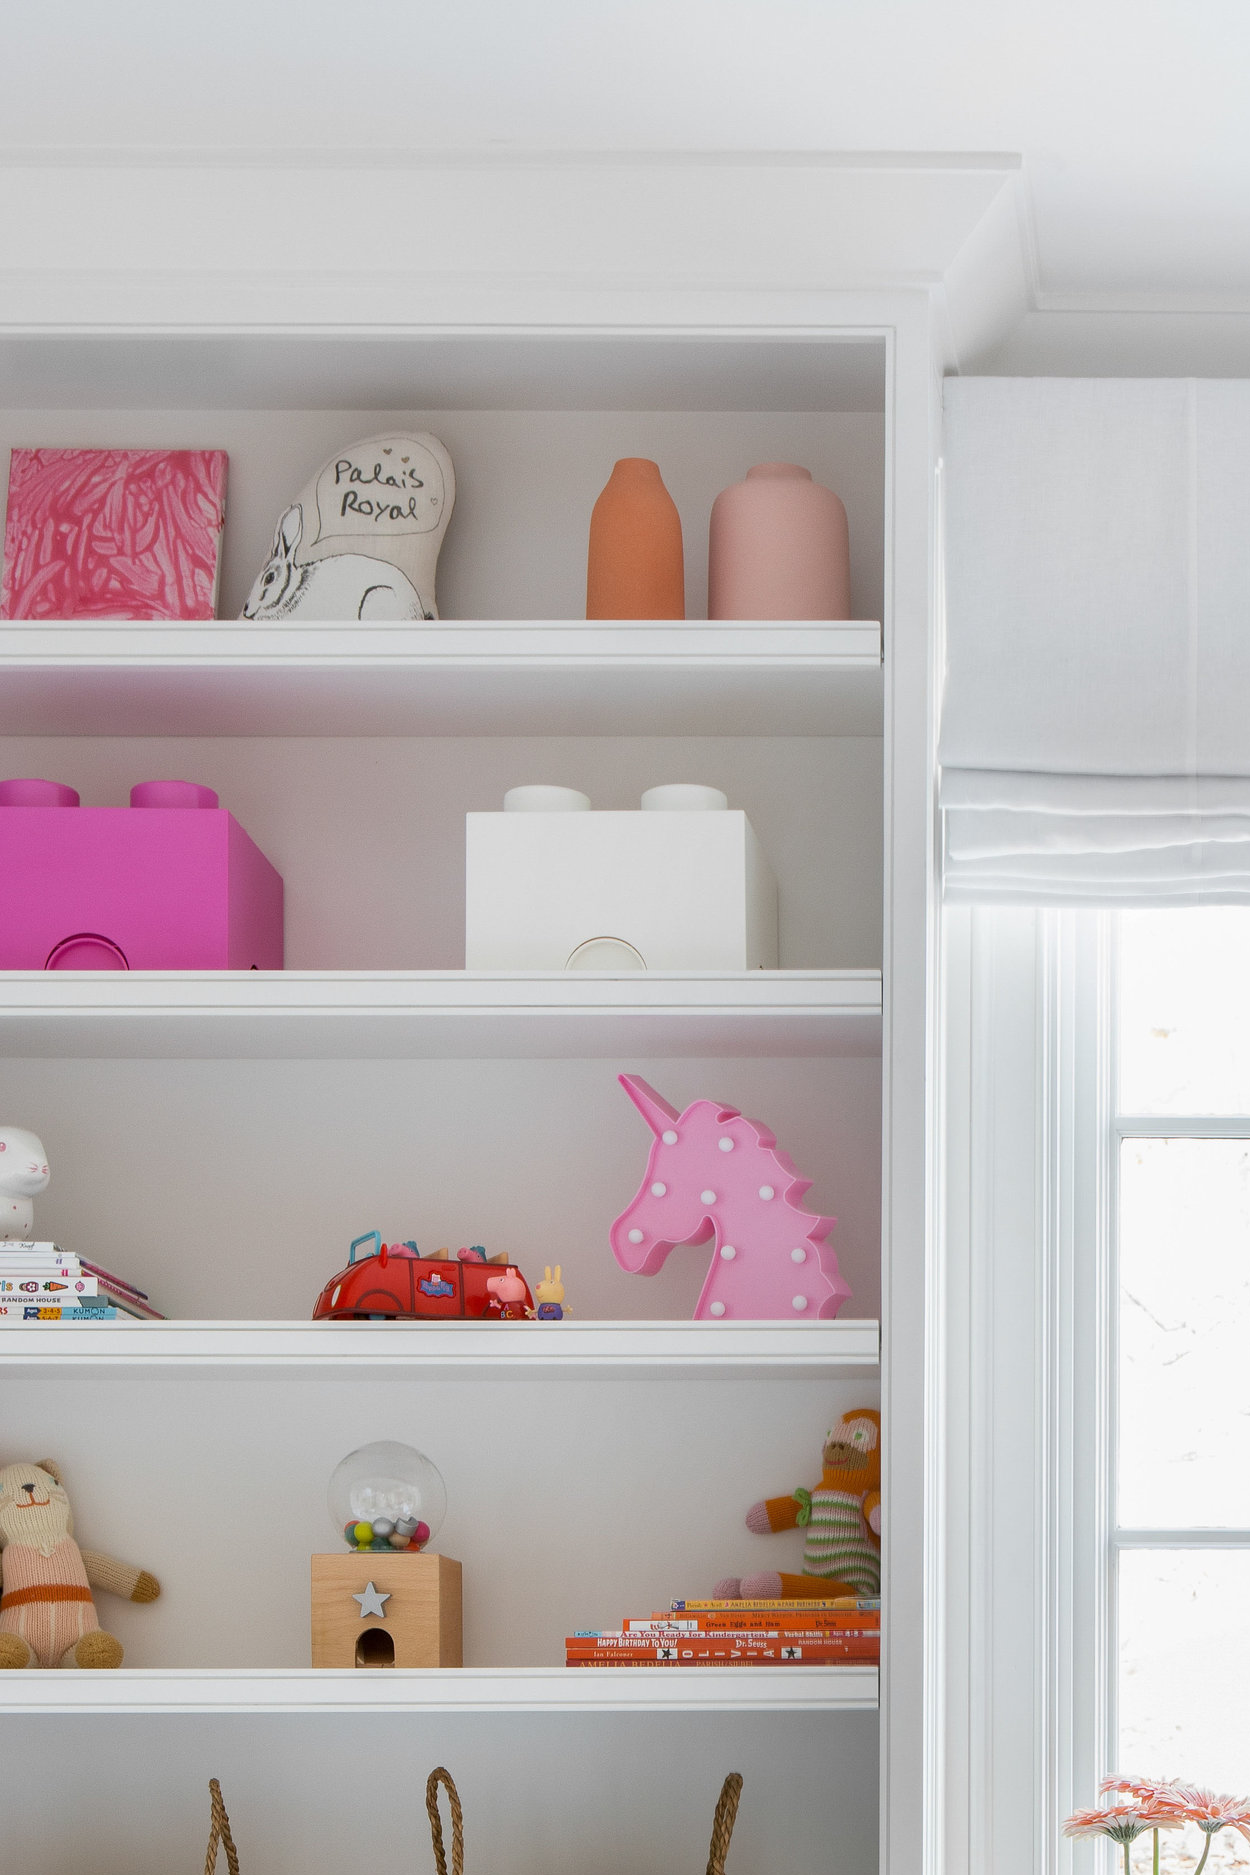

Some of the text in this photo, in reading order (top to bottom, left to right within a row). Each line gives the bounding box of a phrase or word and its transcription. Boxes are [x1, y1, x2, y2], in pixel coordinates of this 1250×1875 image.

[335, 460, 424, 488] Palais
[341, 490, 418, 522] Royal
[73, 1307, 105, 1316] KUMON
[705, 1631, 769, 1639] Kindergarten?
[597, 1638, 617, 1648] HAPPY
[618, 1638, 650, 1648] BIRTHDAY
[660, 1638, 678, 1648] YOU!
[735, 1639, 767, 1648] Dr. Seuss
[682, 1649, 774, 1658] OLIVIA
